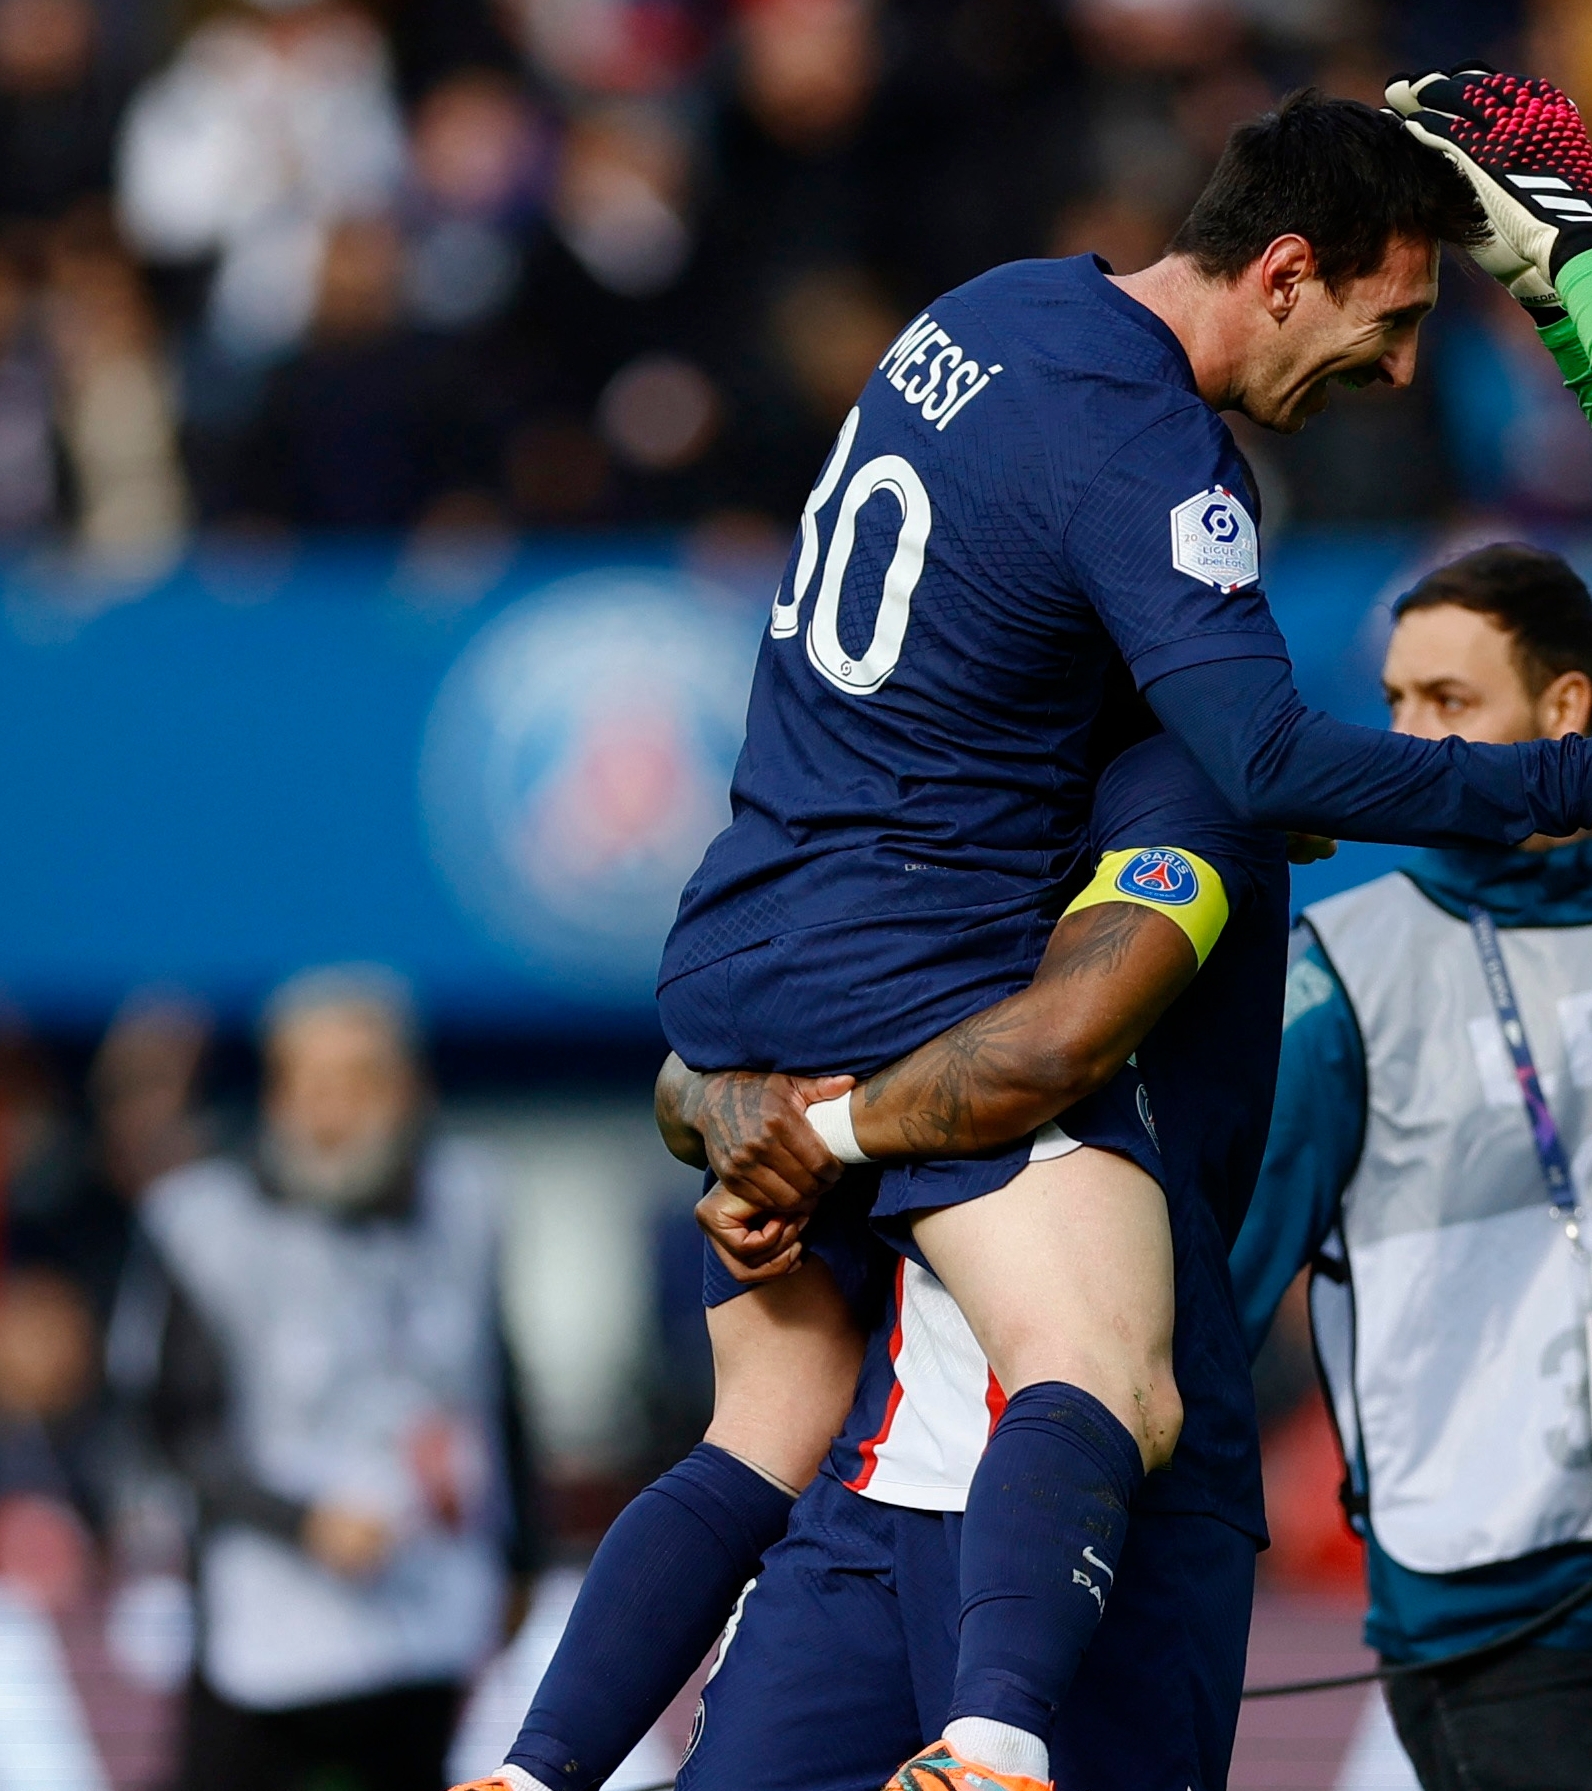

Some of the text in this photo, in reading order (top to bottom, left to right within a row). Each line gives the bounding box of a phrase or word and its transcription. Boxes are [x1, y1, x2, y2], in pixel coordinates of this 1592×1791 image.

[878, 313, 1003, 431] MESSÍ
[1202, 546, 1236, 556] LIGUE
[1197, 557, 1247, 570] Uber Eats
[1140, 852, 1189, 875] PARIS
[1072, 1567, 1106, 1621] PA
